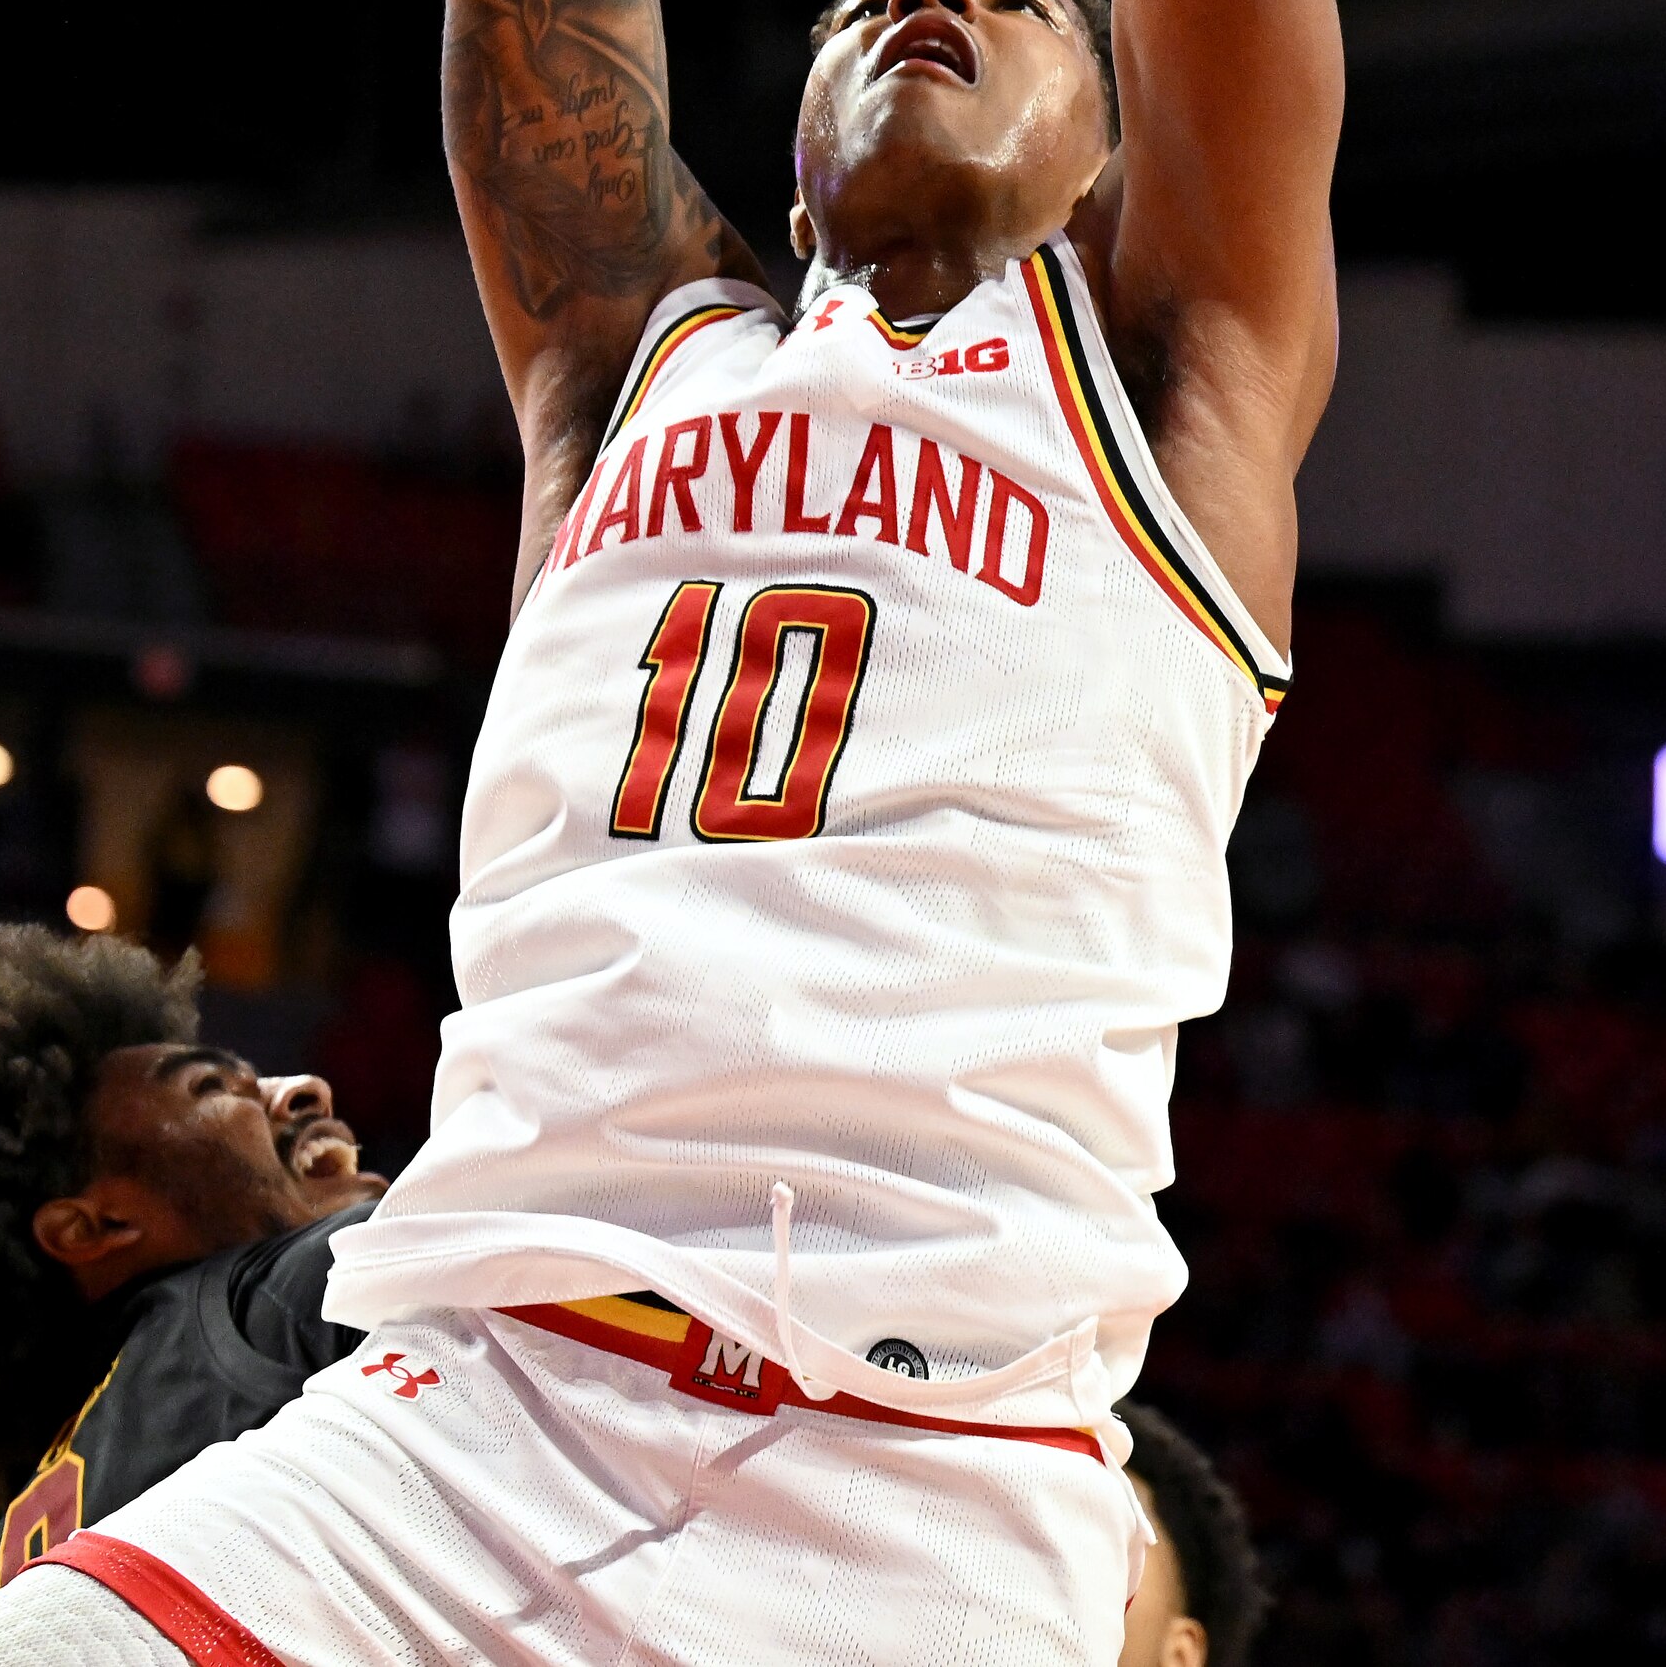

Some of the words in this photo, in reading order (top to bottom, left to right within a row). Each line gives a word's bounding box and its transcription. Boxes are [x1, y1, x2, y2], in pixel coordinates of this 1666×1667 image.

[532, 410, 1050, 607] MARYLAND
[609, 580, 877, 844] 10
[697, 1328, 763, 1390] M
